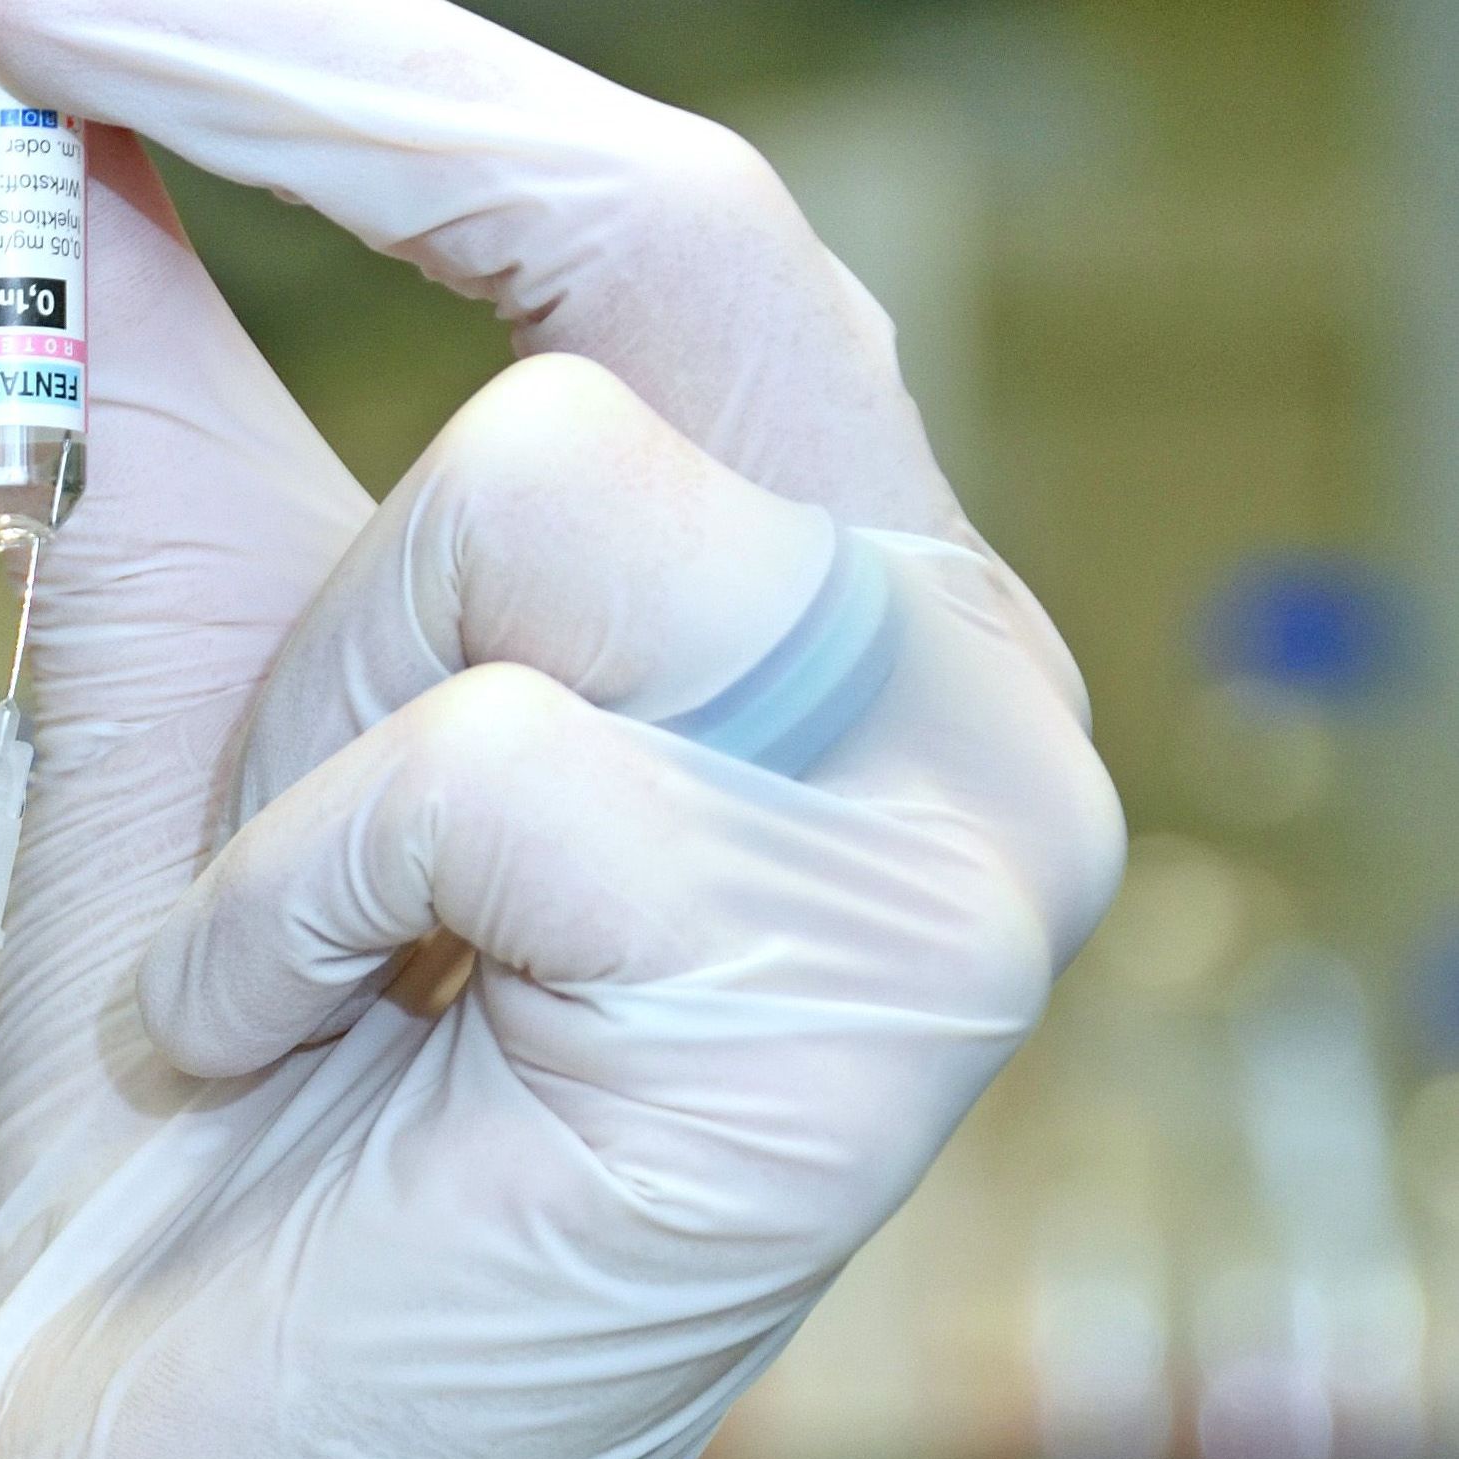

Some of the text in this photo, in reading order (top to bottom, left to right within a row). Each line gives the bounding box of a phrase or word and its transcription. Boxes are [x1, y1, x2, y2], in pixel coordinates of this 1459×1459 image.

[5, 139, 51, 157] oder
[0, 174, 81, 198] Wirkstoff:
[51, 236, 82, 260] 0,05
